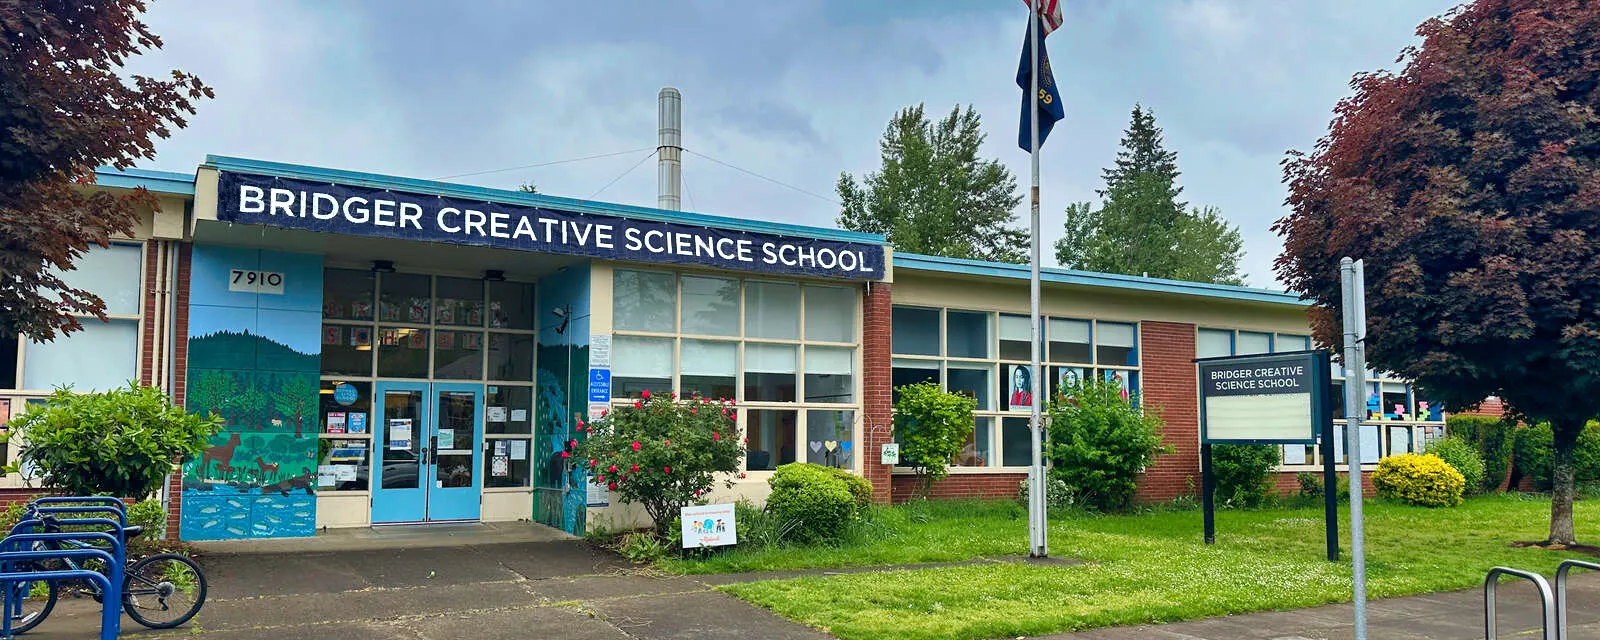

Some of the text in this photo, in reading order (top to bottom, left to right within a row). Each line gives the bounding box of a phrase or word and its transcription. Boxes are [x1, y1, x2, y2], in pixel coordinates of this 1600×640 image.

[239, 184, 874, 272] BRIDGER CREATIVE SCIENCE SCHOOL
[232, 270, 282, 286] 7910
[1211, 366, 1303, 380] BRIDGER CREATIVE
[1215, 378, 1299, 390] SCIENCE SCHOOL
